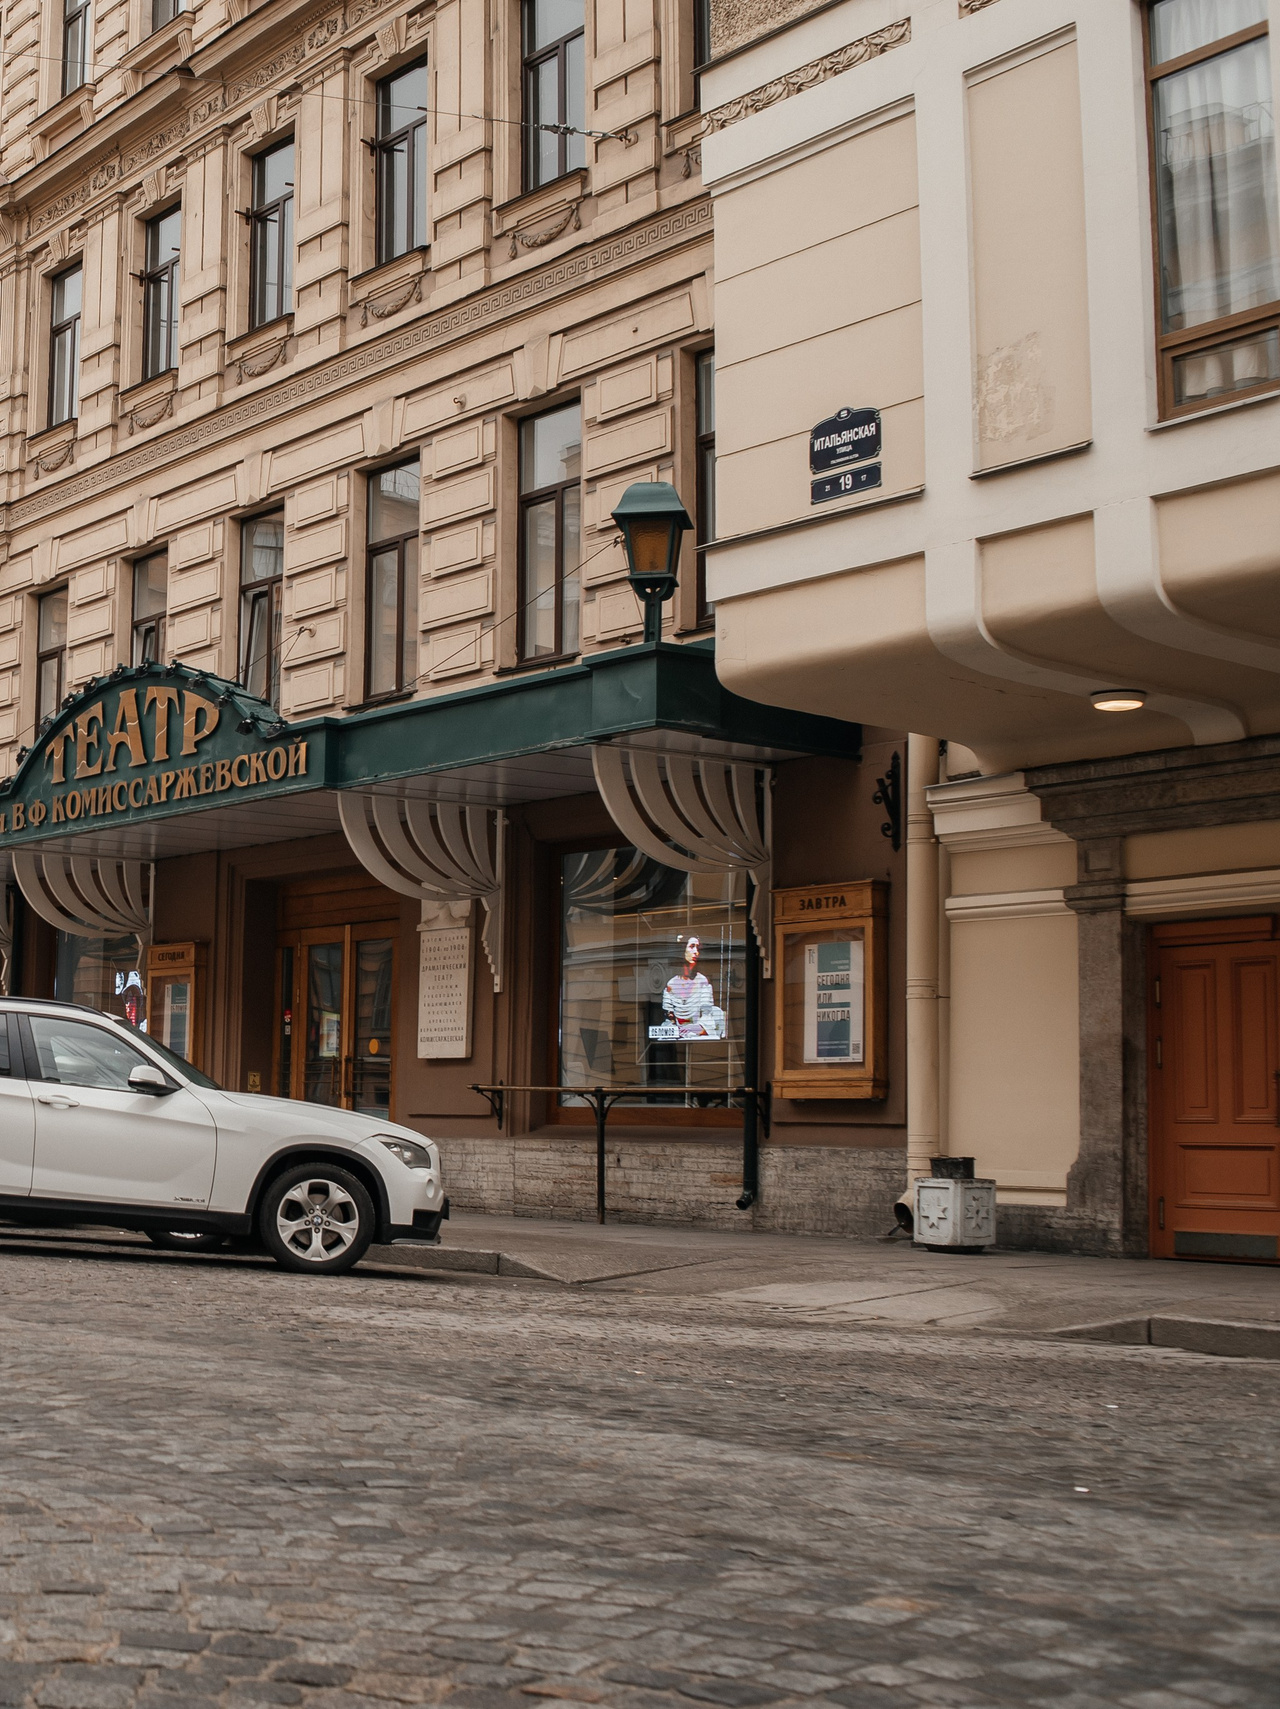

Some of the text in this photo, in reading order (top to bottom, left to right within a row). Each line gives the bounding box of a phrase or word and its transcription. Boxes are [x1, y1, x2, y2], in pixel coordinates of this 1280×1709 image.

[814, 423, 876, 451] ИТАЛЬЯНСКАЯ
[839, 474, 852, 491] 19
[43, 686, 219, 784] ТЕАТР
[51, 736, 307, 823] КОМИССАРЖЕВСКОЙ
[799, 895, 847, 910] ЗАВТРА
[158, 952, 184, 961] СЕГОДНЯ
[422, 963, 466, 972] ДРАМАТИЧЕСКИЙ
[817, 973, 850, 986] СЕГОДНЯ
[817, 992, 832, 1004] ИЛИ
[817, 1010, 850, 1022] НИКОГДА
[652, 1028, 674, 1036] ОБЛОМОВ
